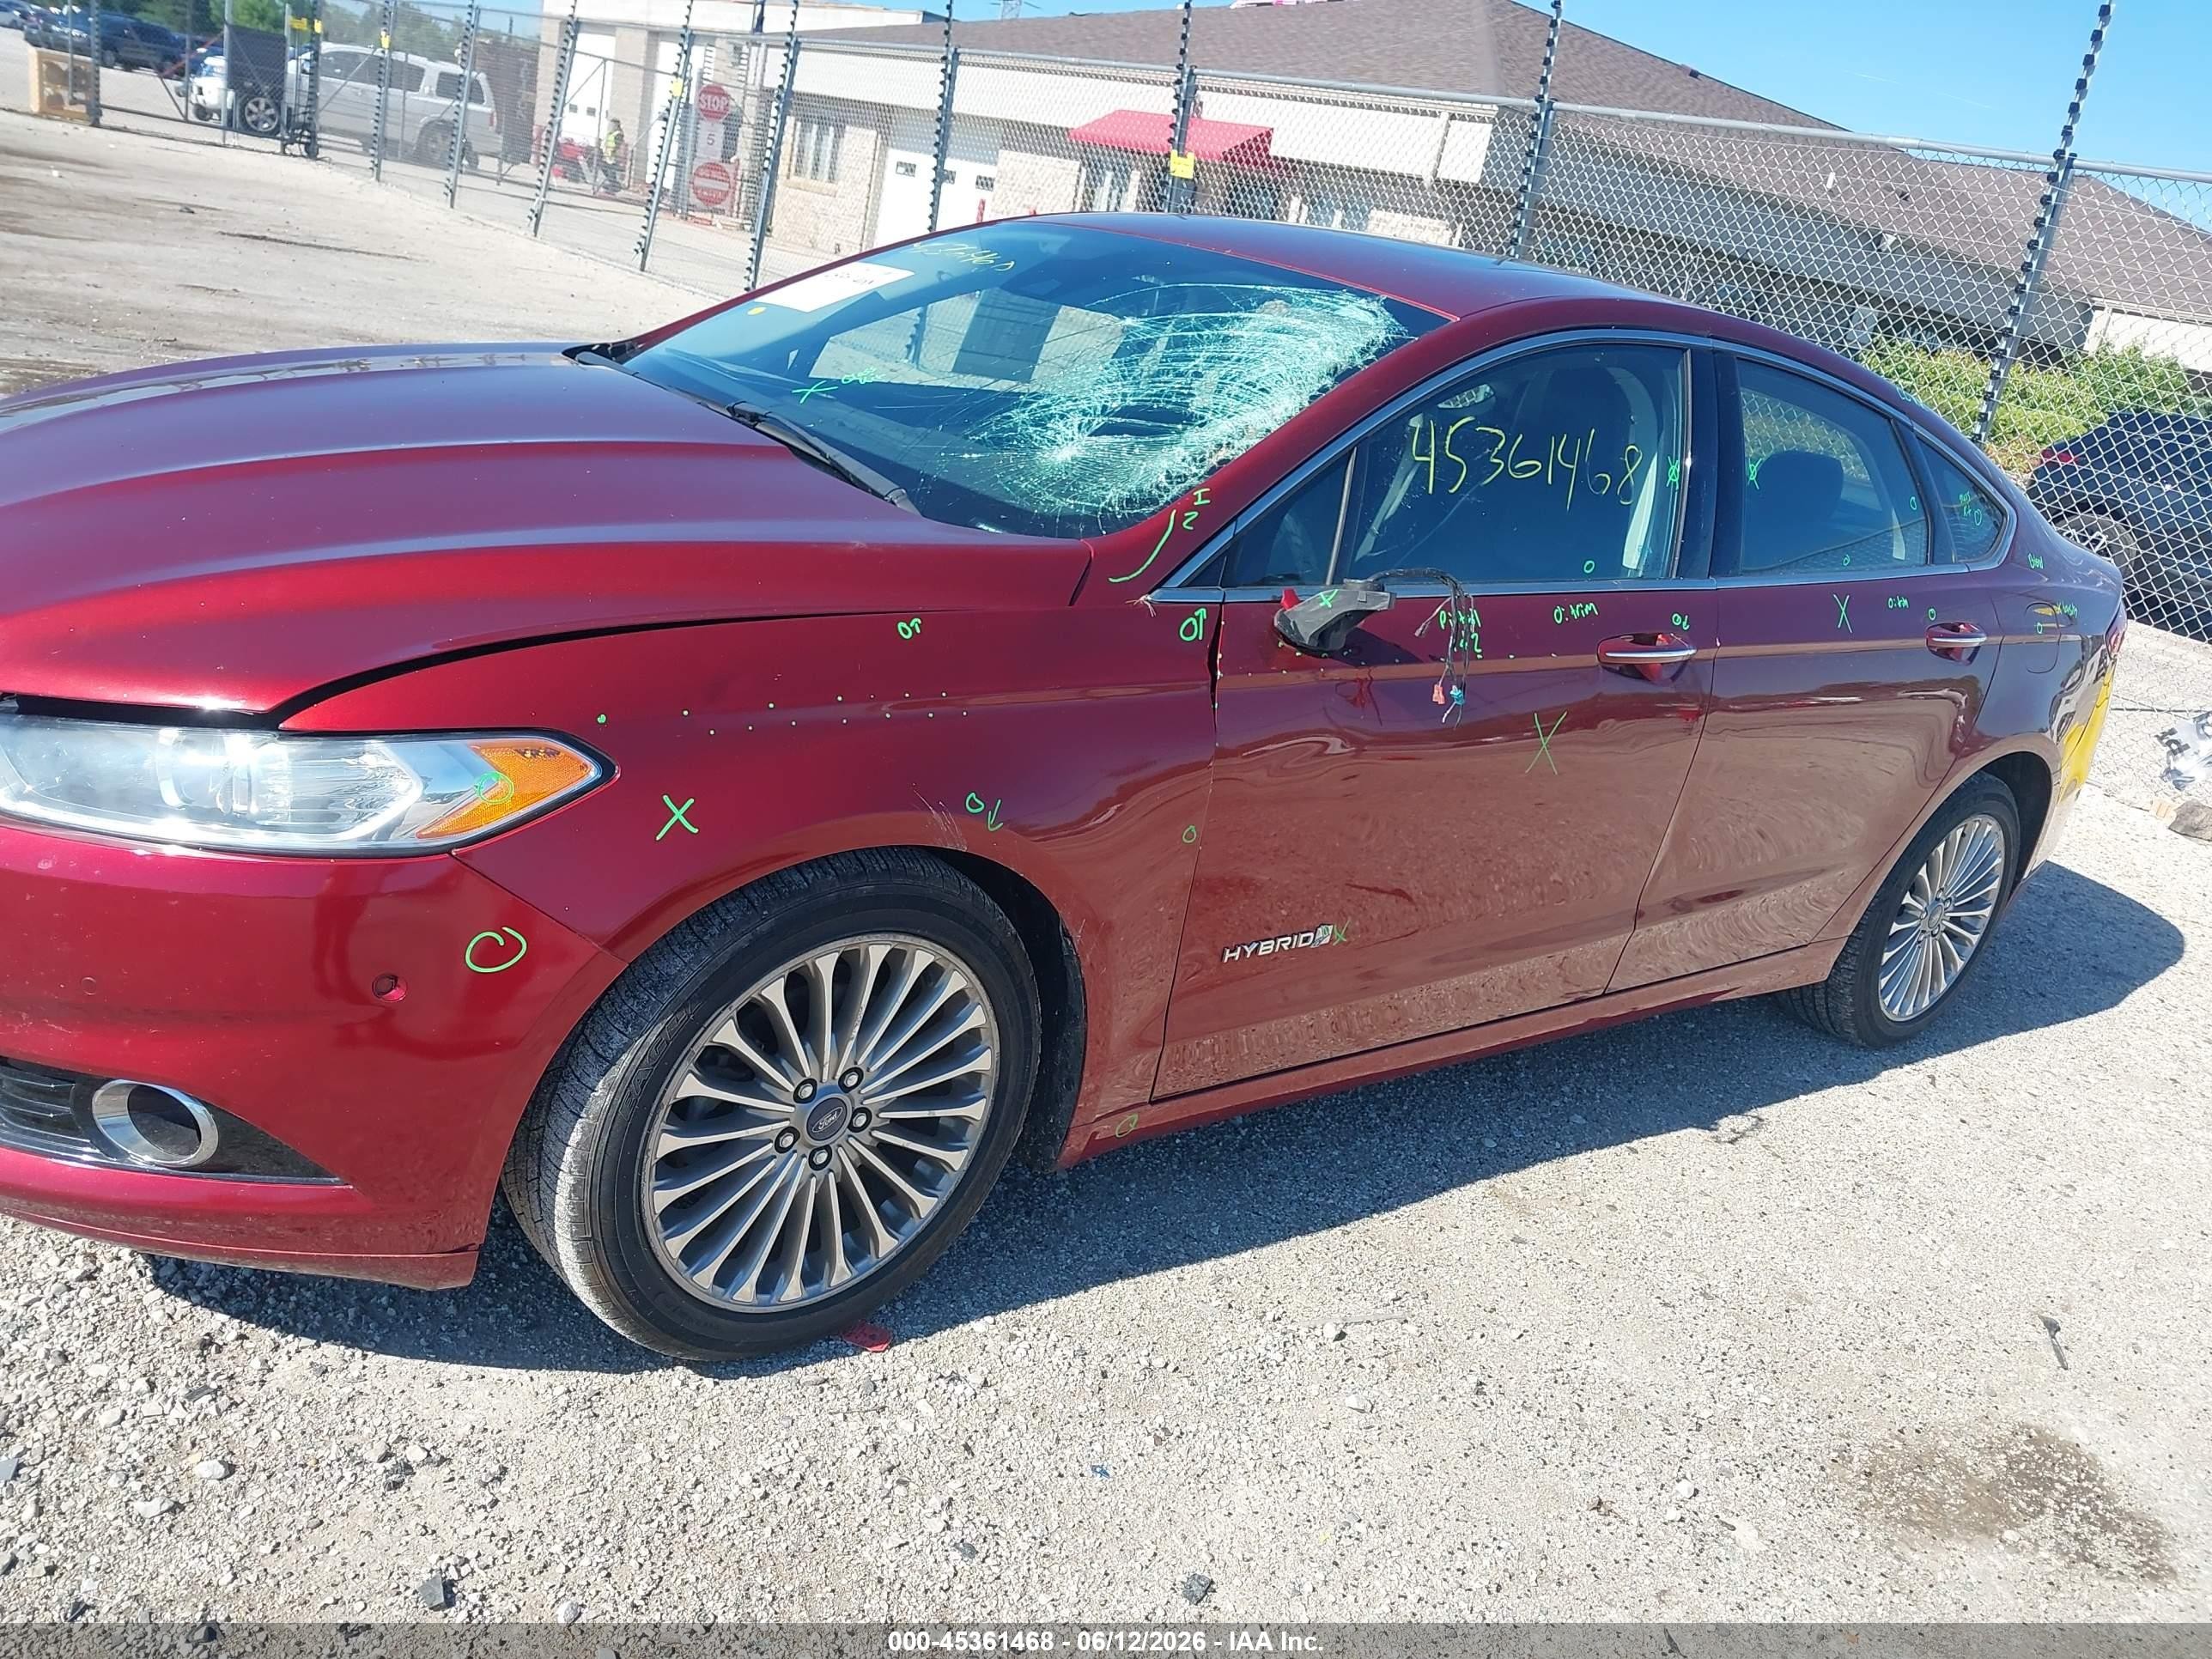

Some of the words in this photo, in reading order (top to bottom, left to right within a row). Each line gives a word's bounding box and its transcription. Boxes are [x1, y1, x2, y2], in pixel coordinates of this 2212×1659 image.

[698, 94, 729, 110] STOP
[1412, 416, 1643, 512] 45361468
[1221, 932, 1316, 963] HYBRID
[817, 1113, 838, 1130] Ford
